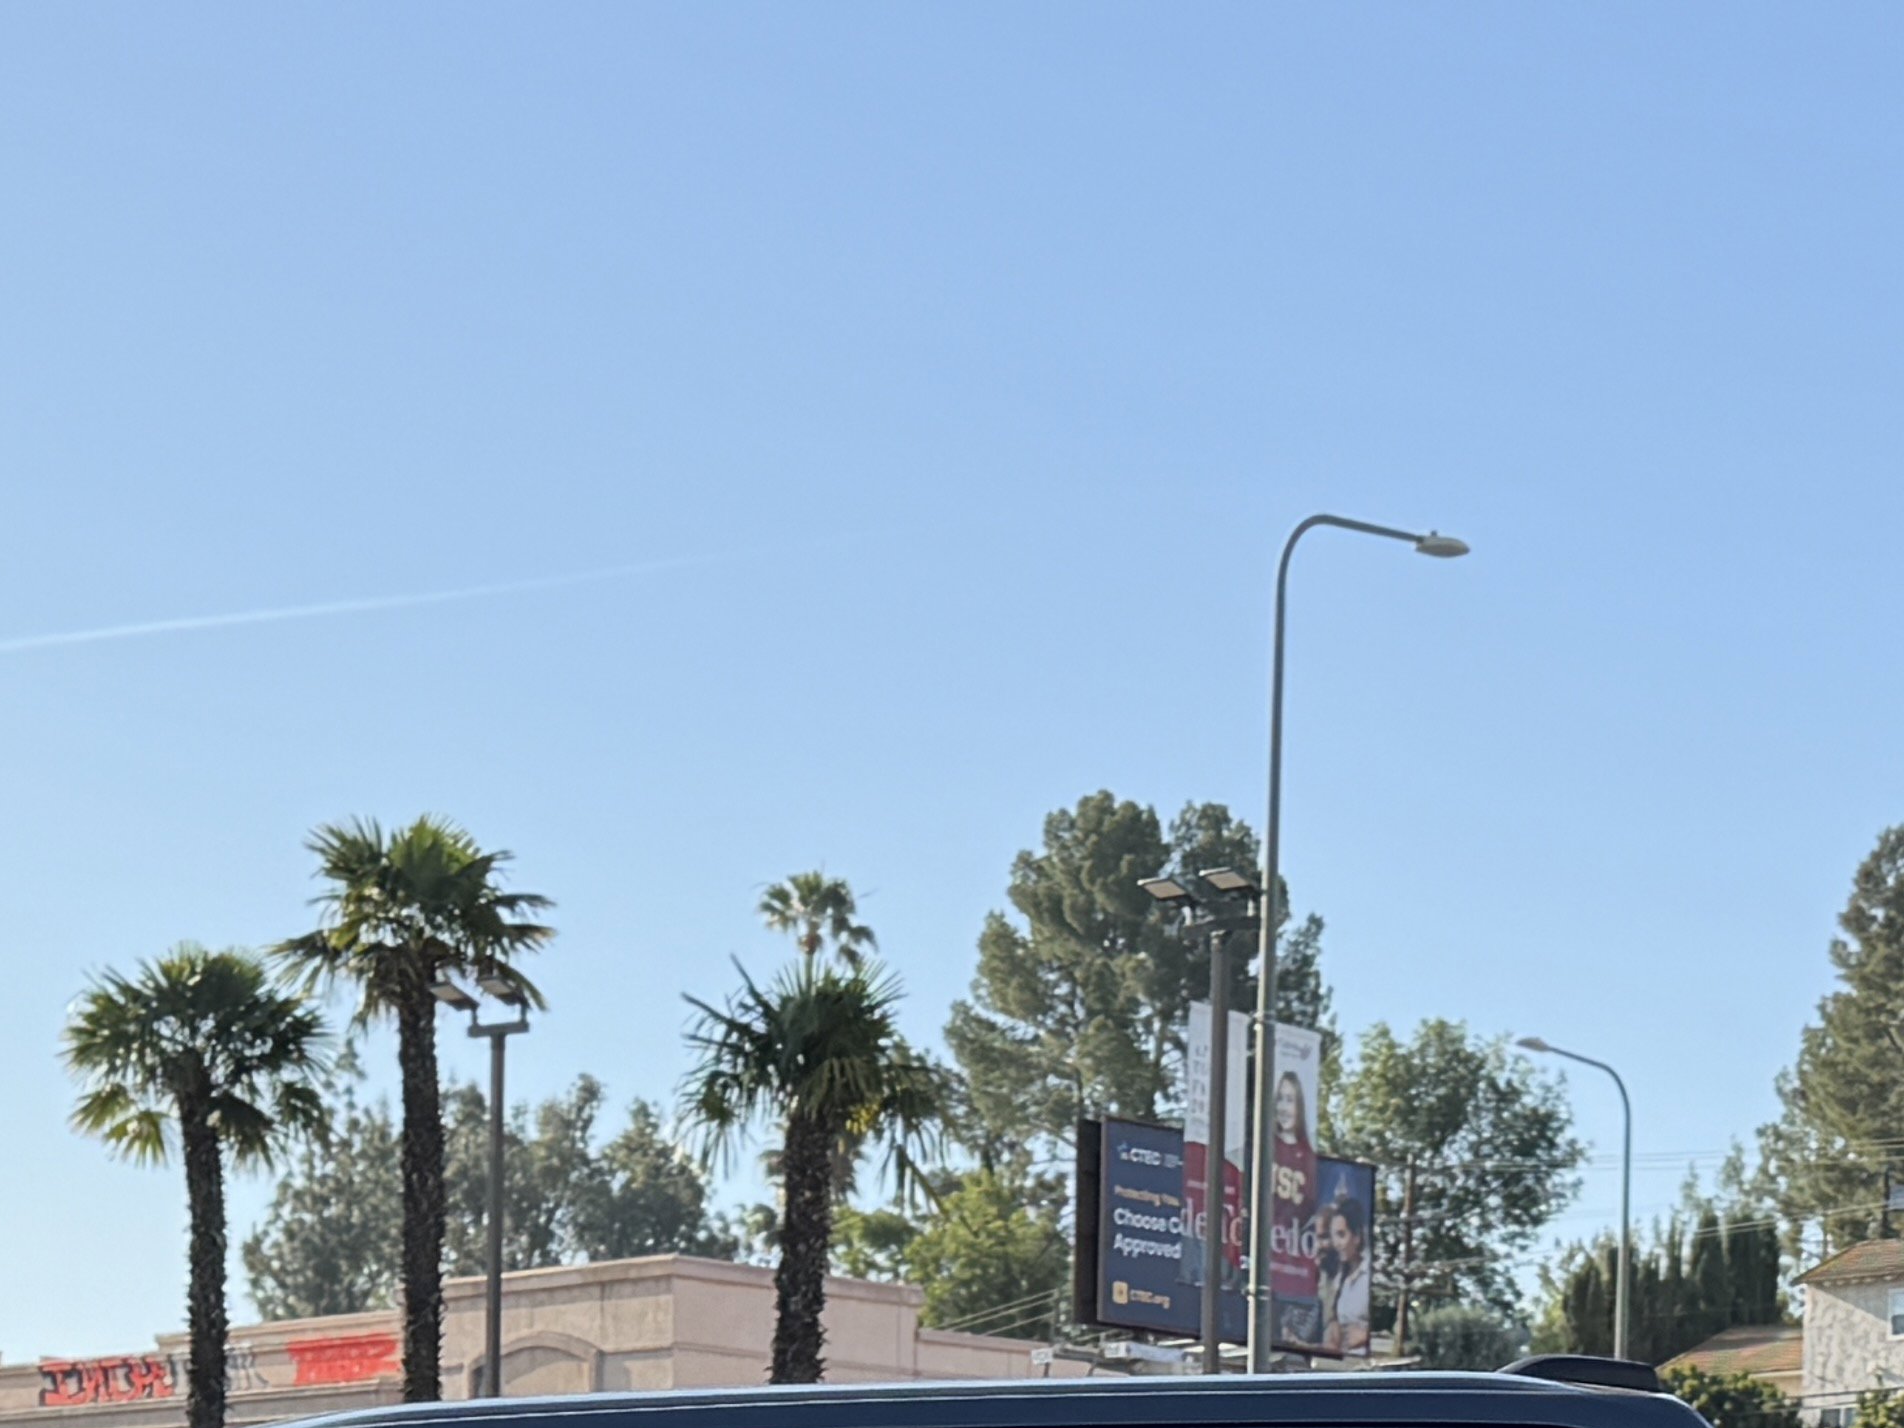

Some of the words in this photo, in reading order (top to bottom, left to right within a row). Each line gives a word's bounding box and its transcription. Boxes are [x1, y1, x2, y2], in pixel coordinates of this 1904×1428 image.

[1272, 1166, 1305, 1205] SC
[1114, 1207, 1167, 1232] Choose
[1114, 1233, 1183, 1259] Approved
